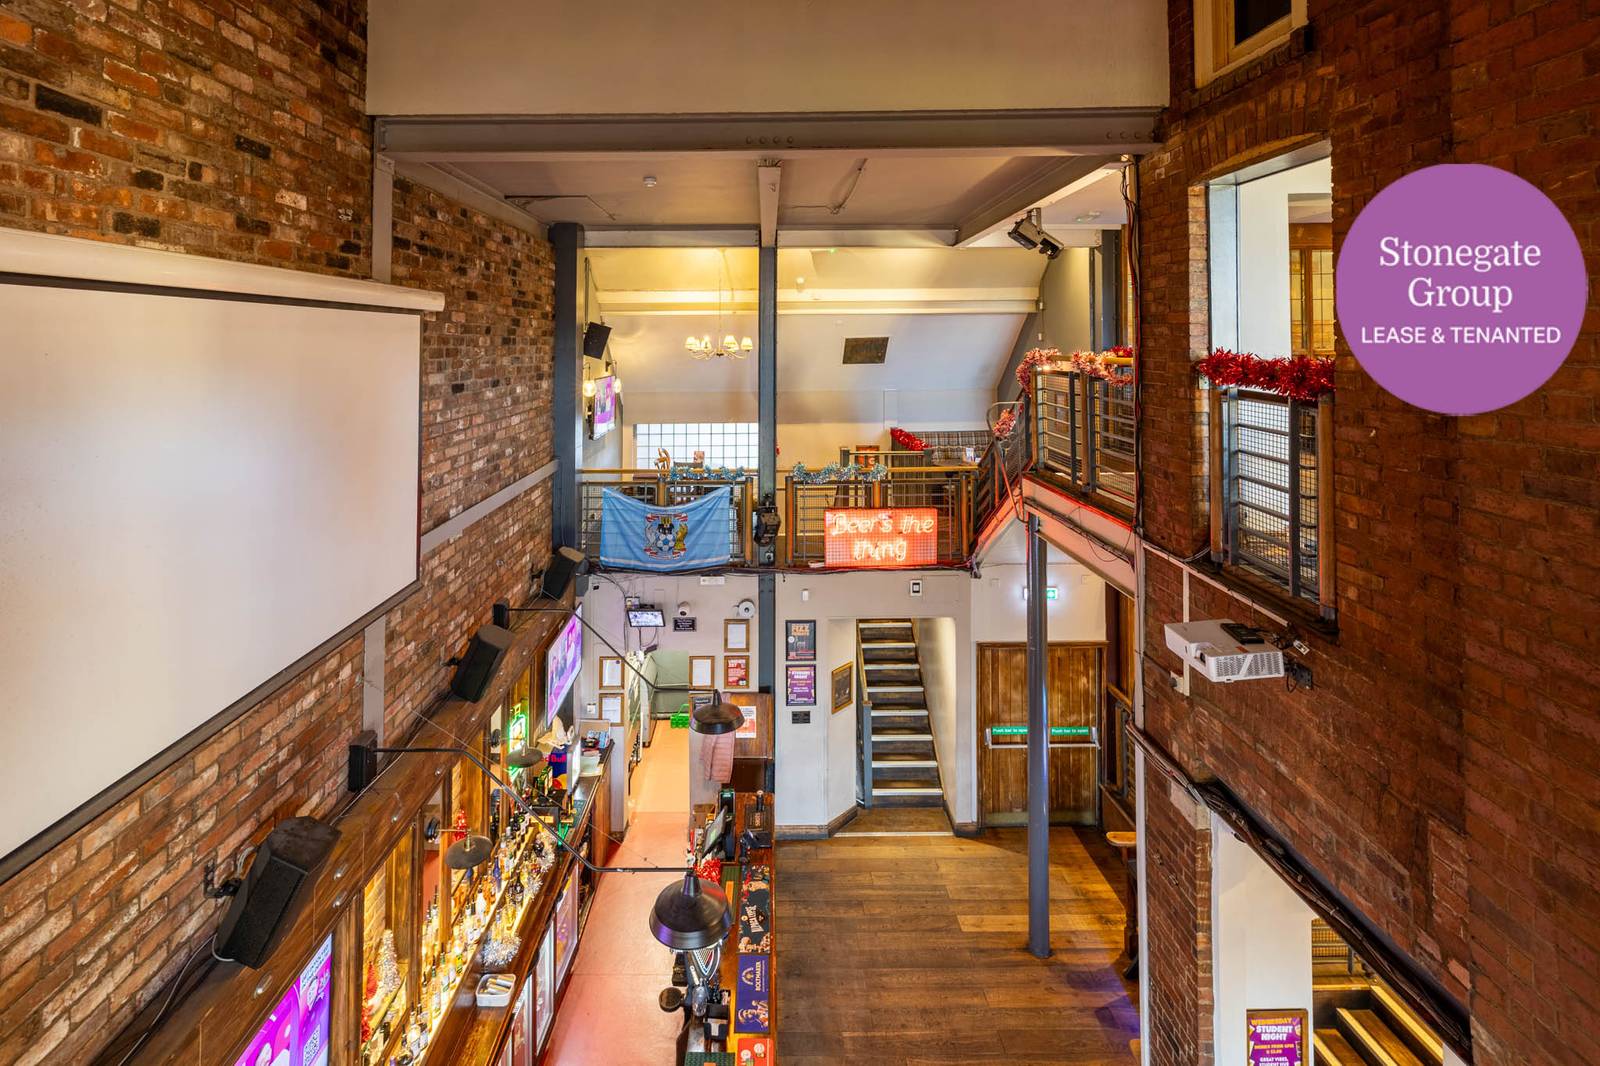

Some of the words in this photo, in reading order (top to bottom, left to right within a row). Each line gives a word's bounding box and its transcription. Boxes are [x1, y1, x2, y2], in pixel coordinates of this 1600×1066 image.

[830, 511, 894, 537] Beer's
[901, 514, 935, 535] the
[852, 538, 908, 562] thing
[1256, 1025, 1293, 1033] STUDENT
